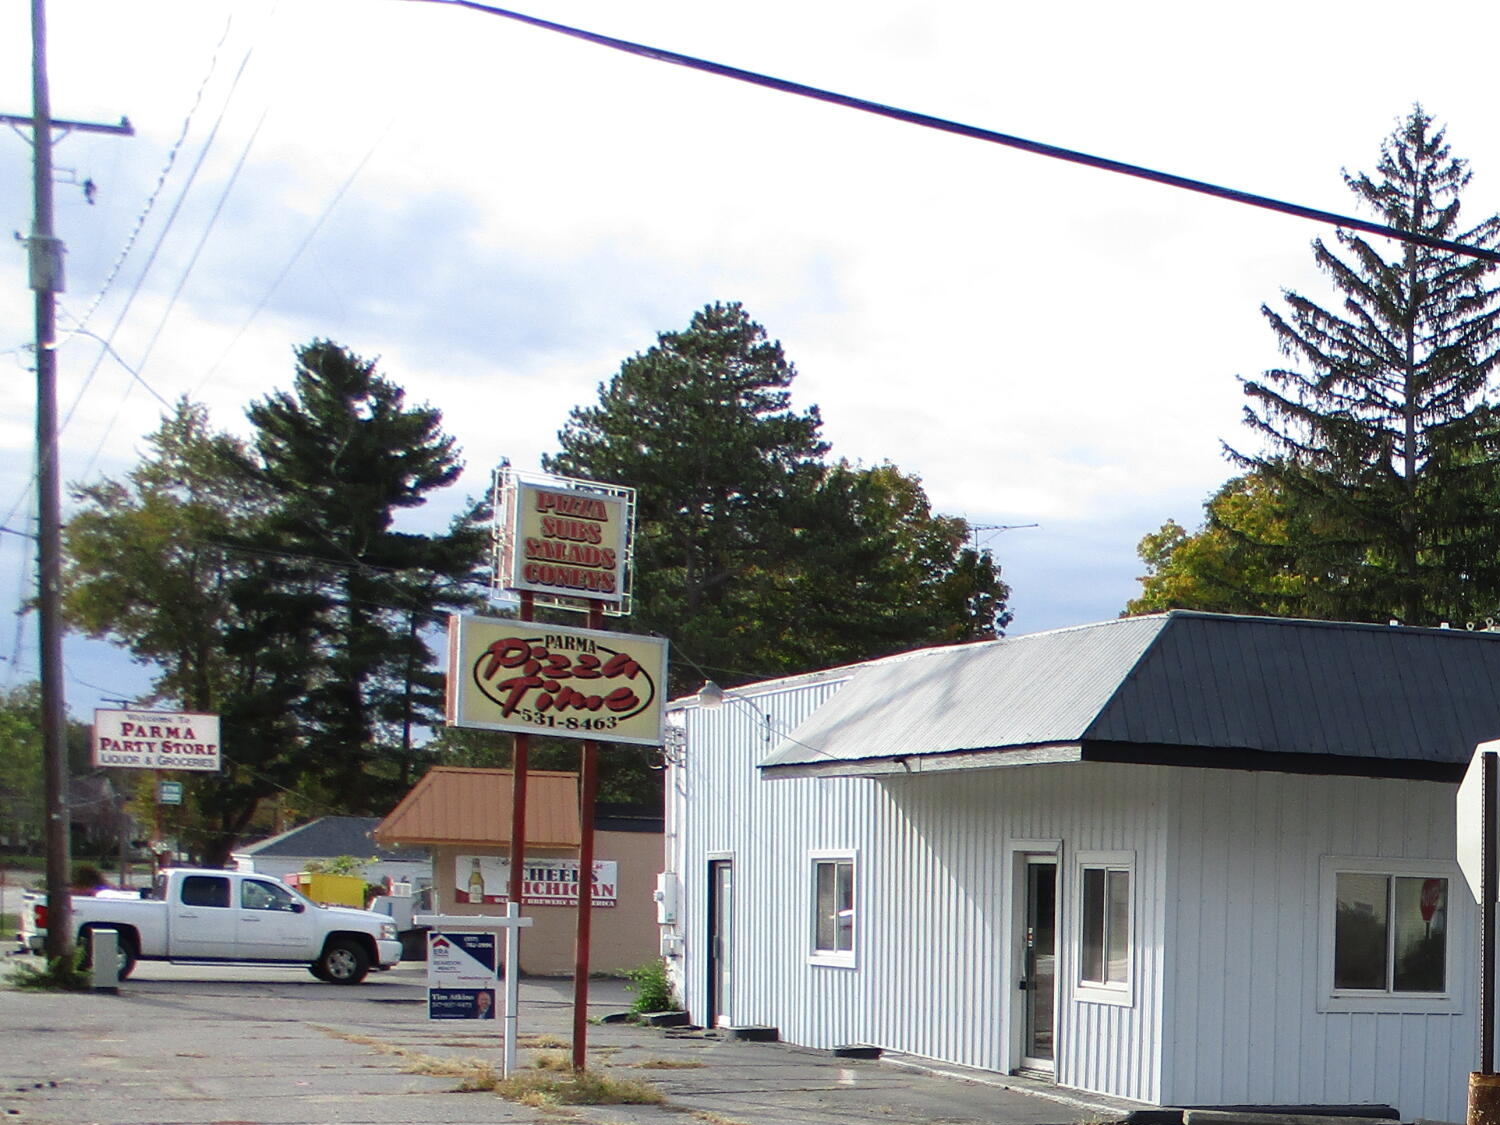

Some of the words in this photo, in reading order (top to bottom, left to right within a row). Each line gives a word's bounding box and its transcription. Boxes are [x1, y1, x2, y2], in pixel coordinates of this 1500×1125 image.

[536, 491, 608, 521] PIZZA
[541, 515, 602, 544] SUBS
[524, 537, 616, 570] SALADS
[523, 563, 616, 593] CONEYS
[544, 634, 597, 654] PARMA
[483, 637, 639, 681] Pizza
[496, 676, 640, 719] Time
[121, 722, 196, 740] PARMA
[520, 709, 618, 730] 531-8463
[99, 737, 157, 753] PARTY
[161, 740, 217, 755] STORE
